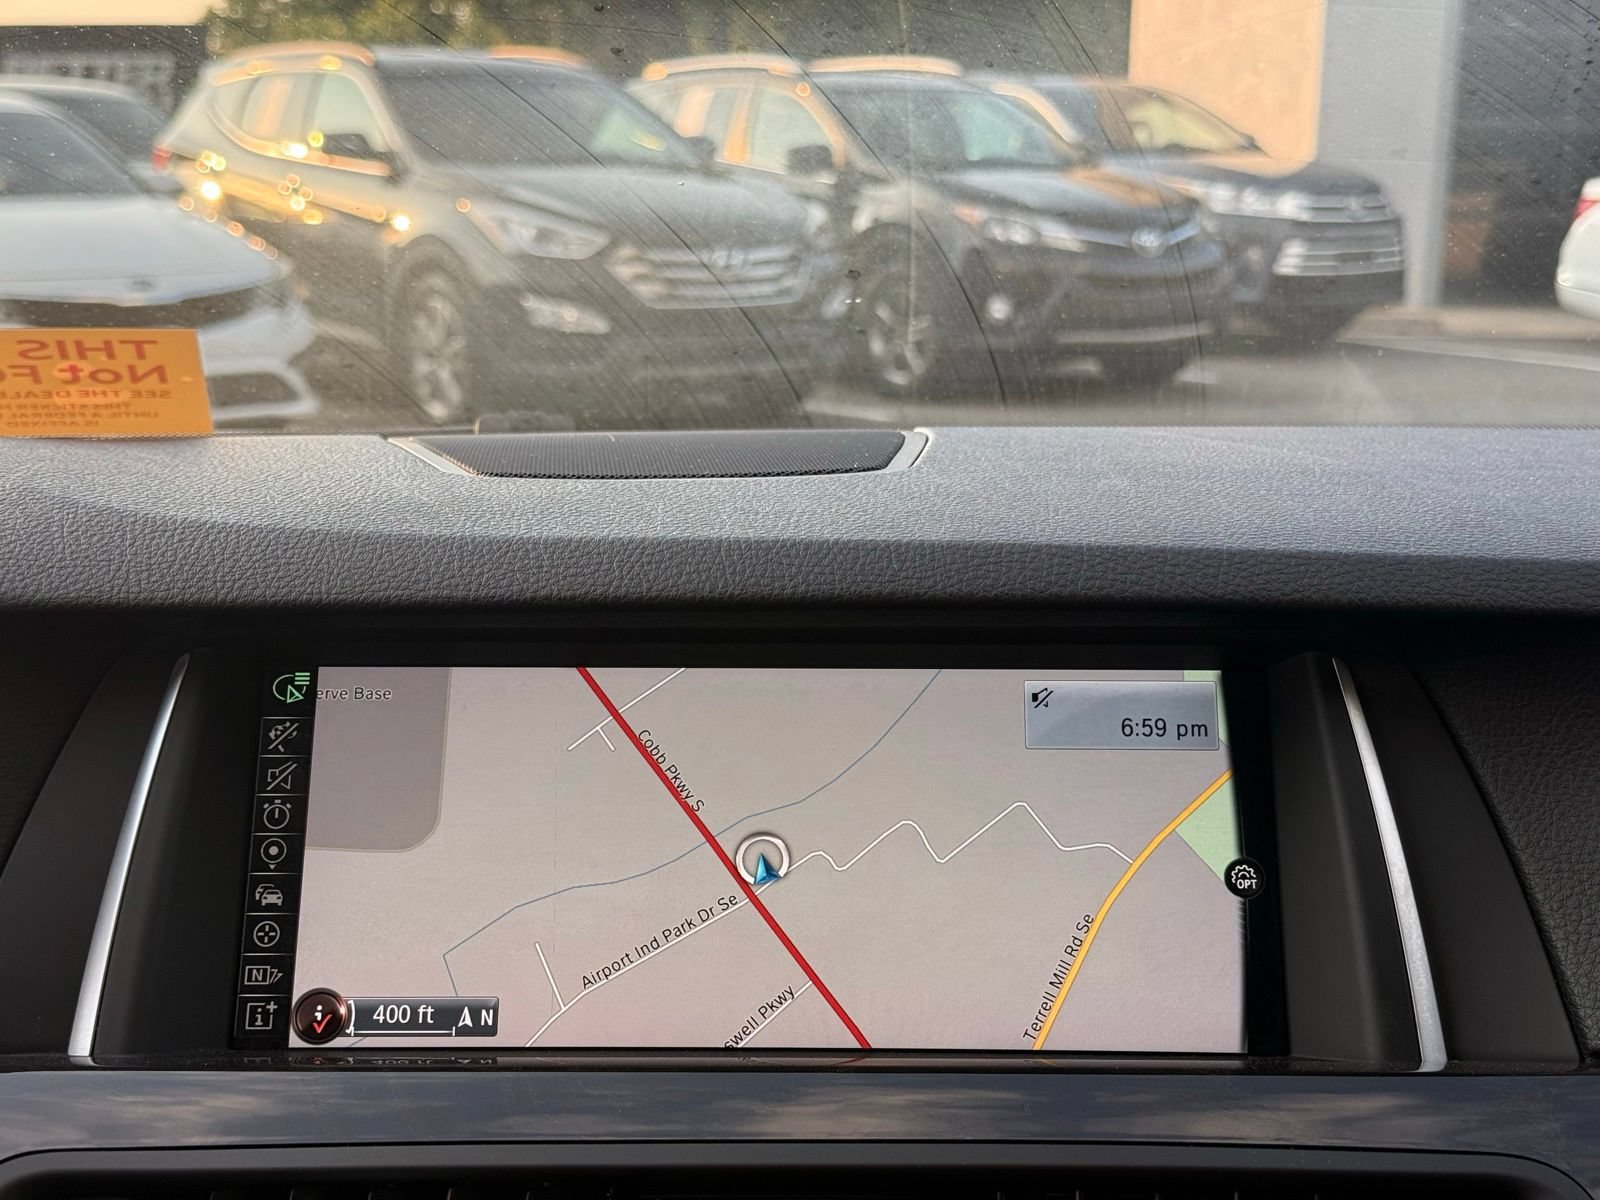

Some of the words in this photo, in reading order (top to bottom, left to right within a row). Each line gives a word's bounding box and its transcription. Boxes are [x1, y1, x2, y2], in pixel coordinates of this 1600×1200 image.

[353, 686, 392, 700] Base
[1121, 717, 1167, 738] 6:59
[1176, 723, 1208, 741] pm
[638, 729, 667, 765] Cobb
[664, 763, 695, 800] Pkwy
[691, 799, 705, 812] S
[1236, 878, 1257, 889] OPT
[581, 952, 634, 989] Airport
[634, 935, 661, 958] Ind
[661, 917, 697, 943] Park
[697, 907, 716, 923] Dr
[717, 894, 739, 911] Se
[1022, 990, 1057, 1040] Terrell
[1048, 959, 1072, 990] Mill
[1063, 935, 1084, 958] Rd
[1075, 913, 1094, 934] Se
[373, 1004, 411, 1024] 400
[417, 1004, 435, 1024] ft
[757, 985, 795, 1020] Pkwy
[480, 1009, 494, 1026] N
